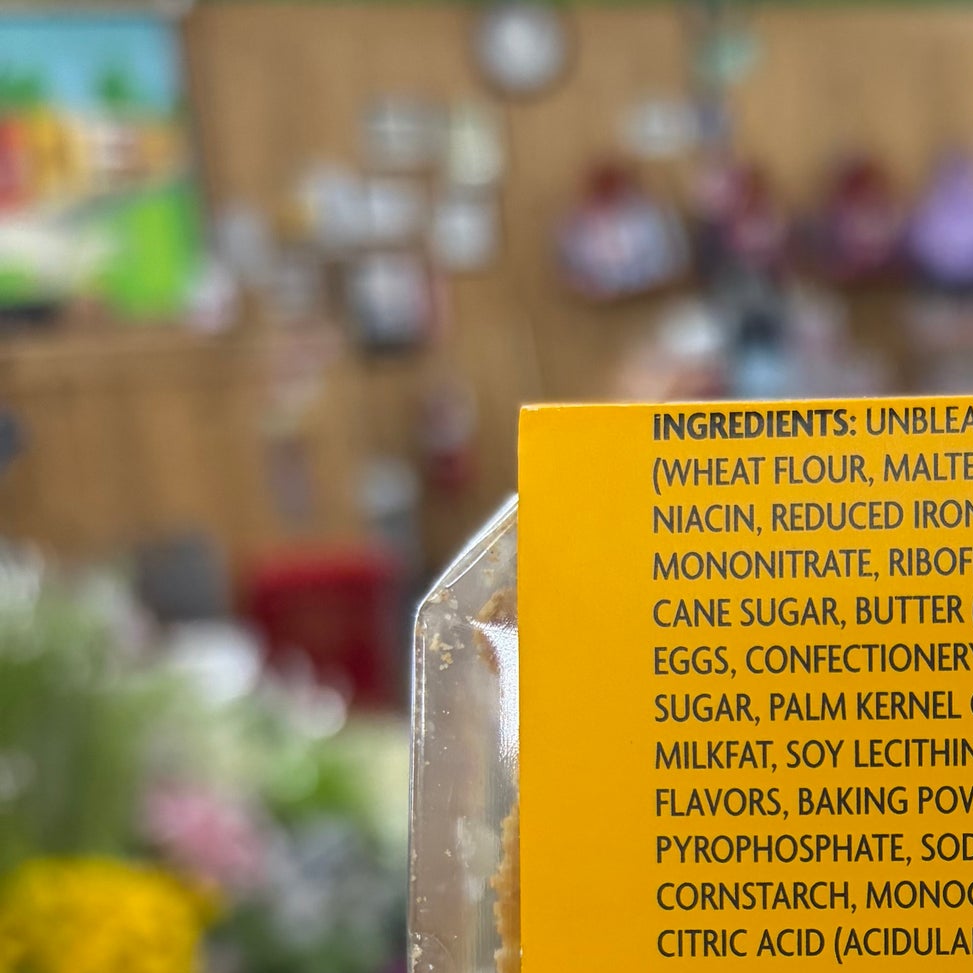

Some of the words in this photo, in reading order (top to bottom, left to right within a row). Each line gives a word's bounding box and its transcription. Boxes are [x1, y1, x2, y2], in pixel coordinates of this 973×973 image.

[653, 409, 857, 440] INGREDIENTS:
[654, 457, 765, 494] (WHEAT
[775, 455, 873, 486] FLOUR,
[654, 505, 761, 535] NIACIN,
[773, 502, 903, 530] REDUCED
[654, 550, 878, 580] MONONITRATE,
[654, 599, 731, 627] CANE
[741, 598, 845, 629] SUGAR,
[857, 595, 964, 624] BUTTER
[655, 646, 736, 678] EGGS,
[655, 694, 760, 725] SUGAR,
[770, 693, 846, 721] PALM
[857, 691, 961, 720] KERNEL
[656, 741, 776, 772] MILKFAT,
[787, 740, 844, 768] SOY
[656, 788, 788, 820] FLAVORS,
[799, 786, 907, 815] BAKING
[657, 834, 911, 866] PYROPHOSPHATE,
[657, 882, 856, 913] CORNSTARCH,
[658, 929, 747, 957] CITRIC
[757, 929, 824, 956] ACID
